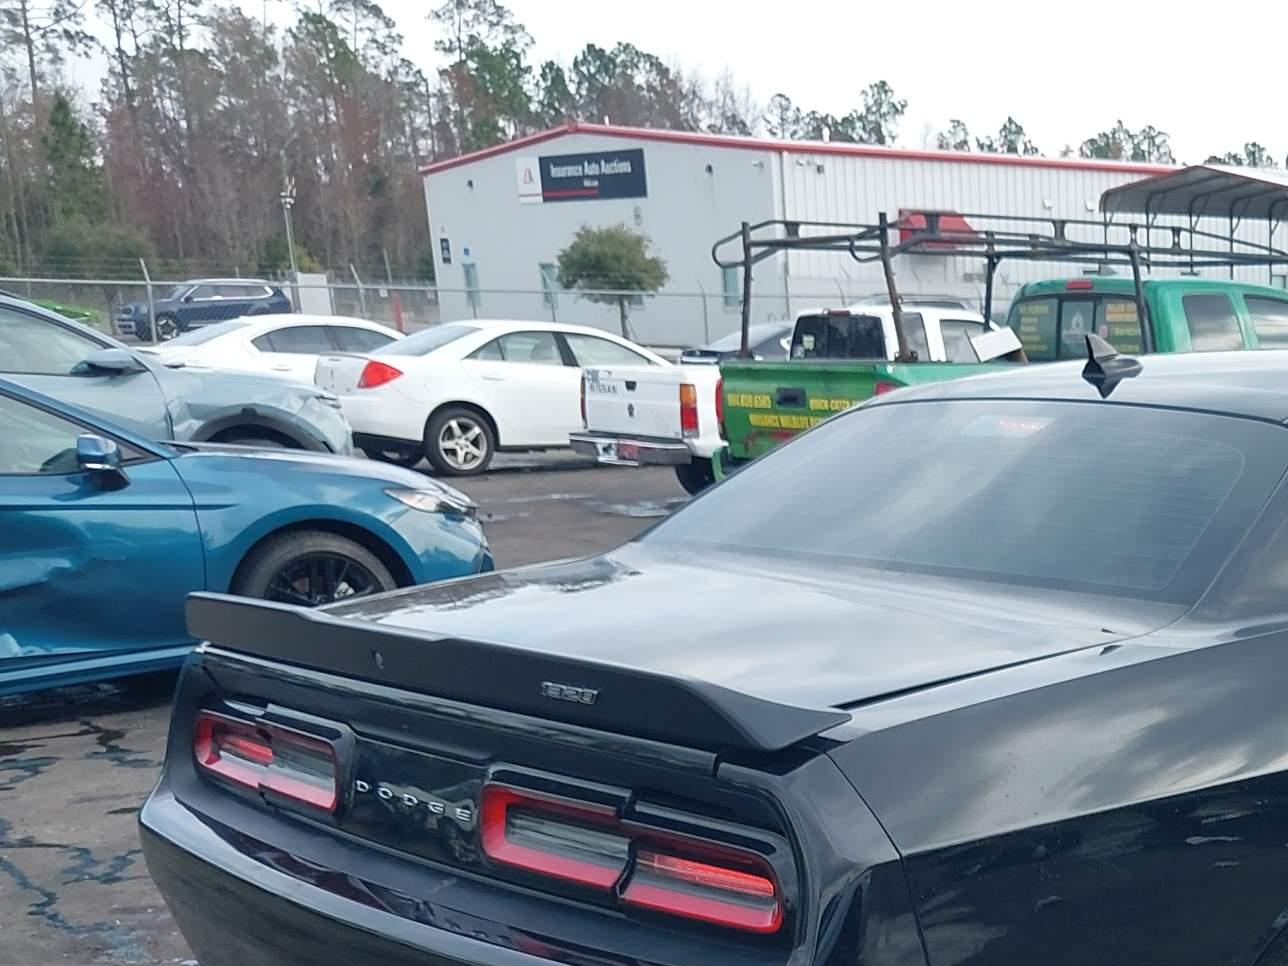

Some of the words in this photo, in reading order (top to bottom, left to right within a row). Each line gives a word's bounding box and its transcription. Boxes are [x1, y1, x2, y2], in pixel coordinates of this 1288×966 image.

[550, 163, 582, 178] Insurance
[583, 160, 600, 176] Auto
[601, 159, 631, 174] Auctions
[589, 383, 618, 395] NISSAN
[356, 780, 471, 822] DODGE
